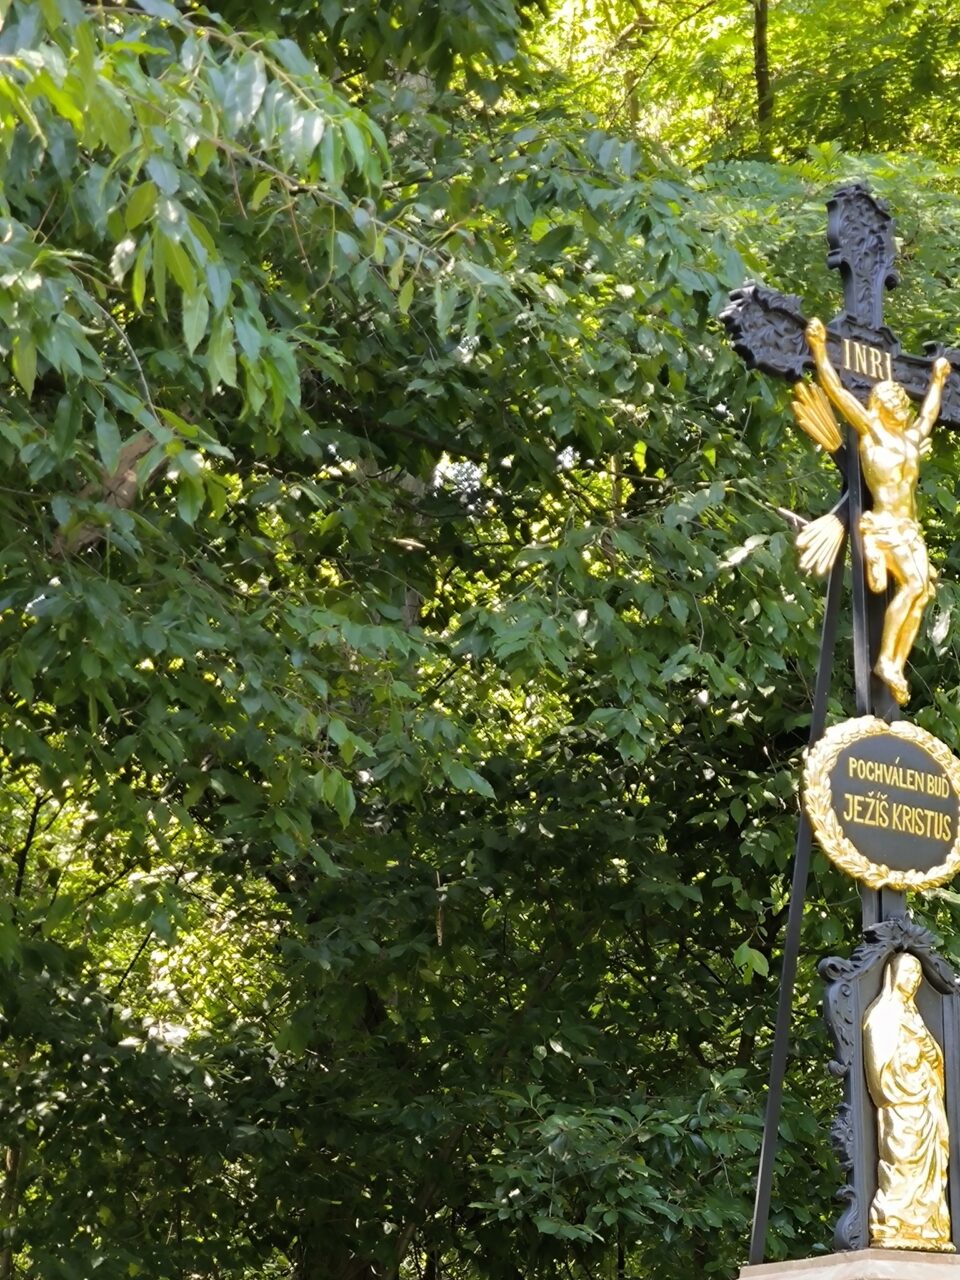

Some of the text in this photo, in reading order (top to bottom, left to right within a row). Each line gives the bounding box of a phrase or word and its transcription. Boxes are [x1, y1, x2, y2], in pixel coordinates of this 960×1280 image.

[843, 338, 892, 381] INRI
[848, 756, 925, 792] POCHVÁLEN
[843, 791, 952, 842] JEŽÍŠ KRISTUS
